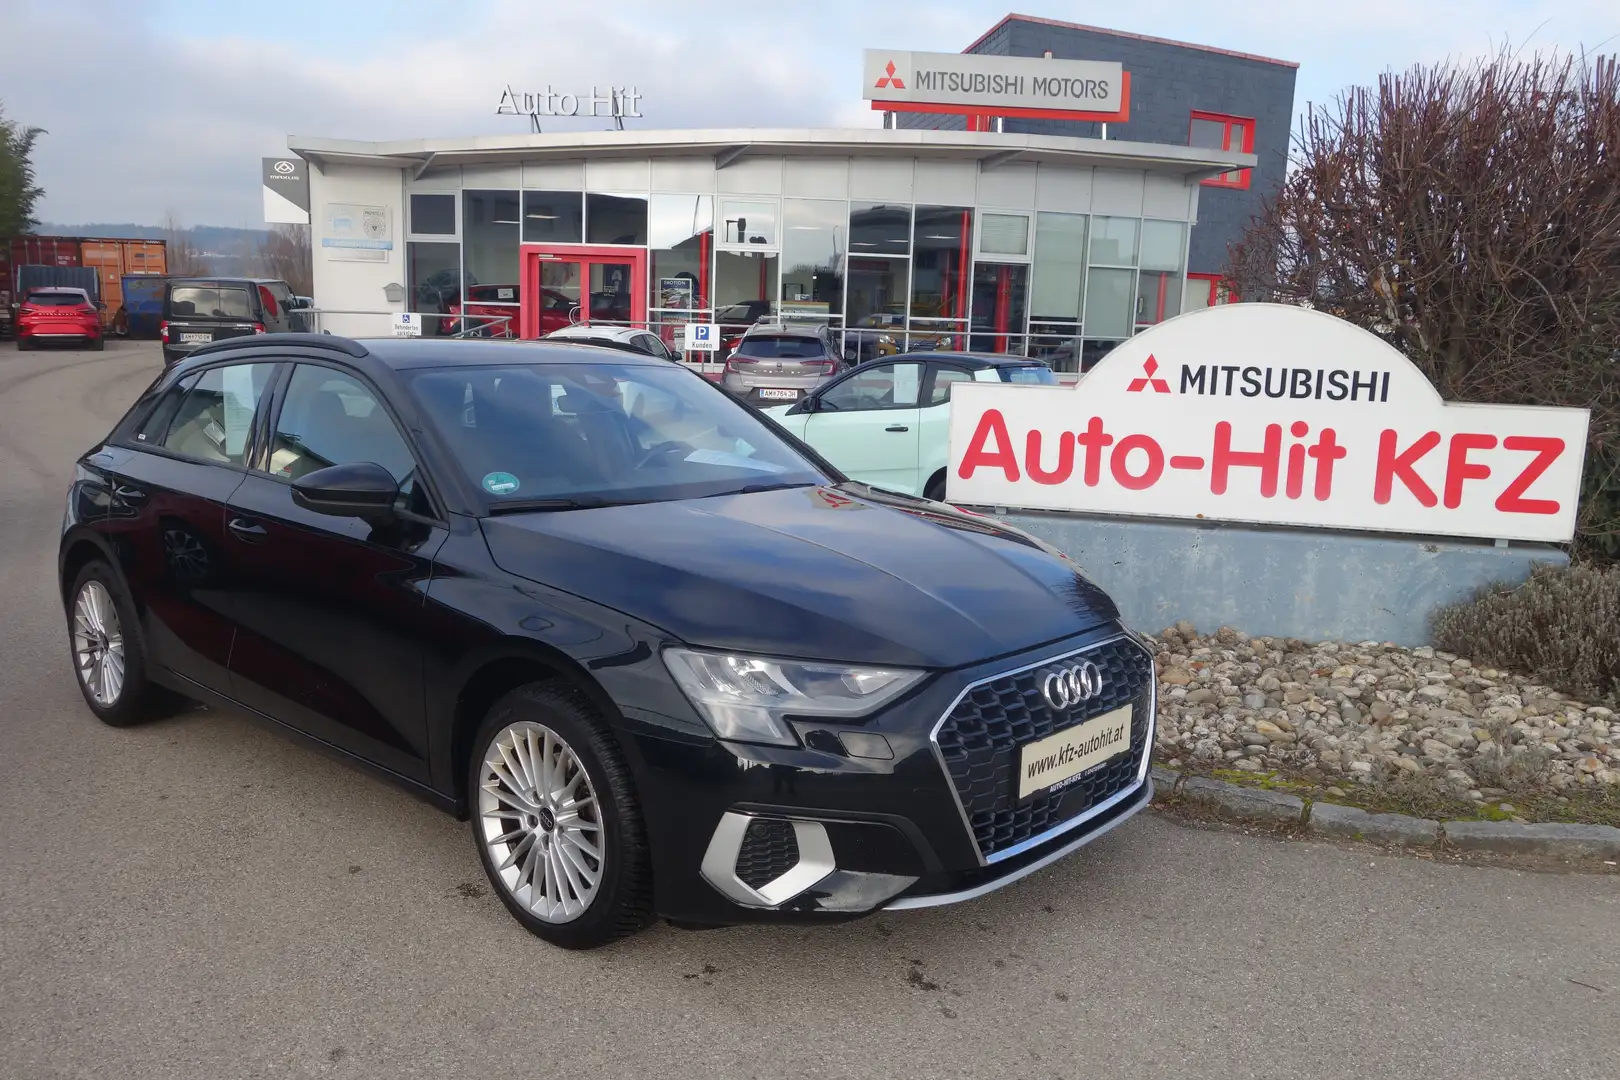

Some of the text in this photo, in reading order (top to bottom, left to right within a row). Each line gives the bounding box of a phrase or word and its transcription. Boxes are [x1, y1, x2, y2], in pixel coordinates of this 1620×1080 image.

[497, 84, 643, 117] Auto Hit
[915, 70, 1109, 100] MITSUBISHI MOTORS
[1180, 363, 1390, 402] MITSUBISHI
[958, 408, 1566, 515] Auto-Hit KFZ
[1027, 723, 1124, 778] www.kfz-autohit.at
